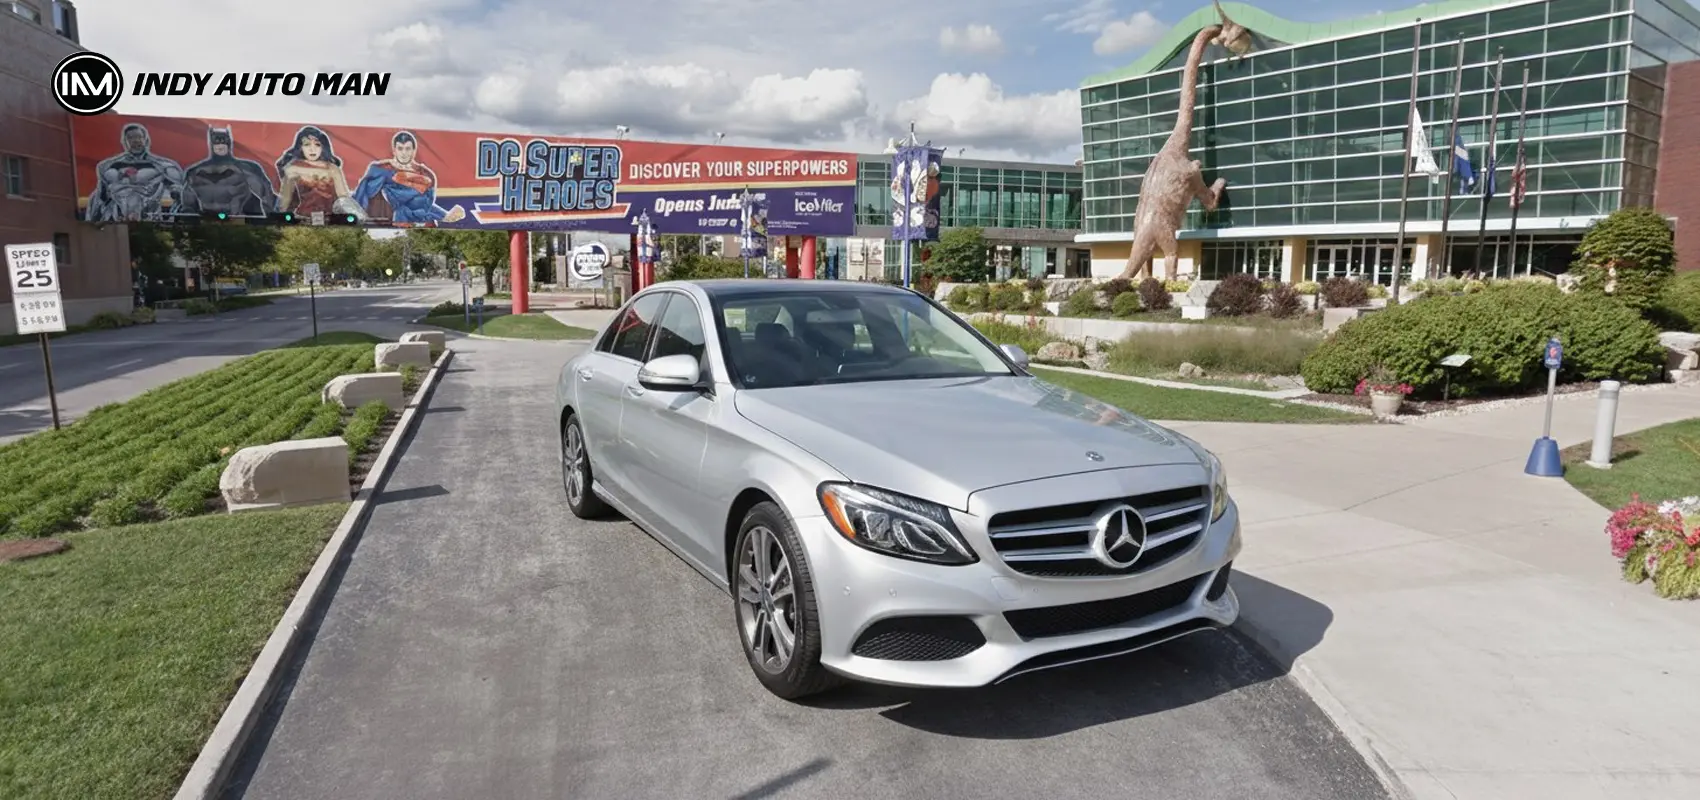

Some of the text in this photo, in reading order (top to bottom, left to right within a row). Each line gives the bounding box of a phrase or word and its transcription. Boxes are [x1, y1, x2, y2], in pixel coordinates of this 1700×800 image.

[479, 140, 619, 179] DC SUPER
[629, 159, 848, 180] DISCOVER YOUR SUPERPOWERS
[503, 176, 615, 212] HEROES
[654, 197, 704, 217] Opens
[17, 269, 53, 288] 25
